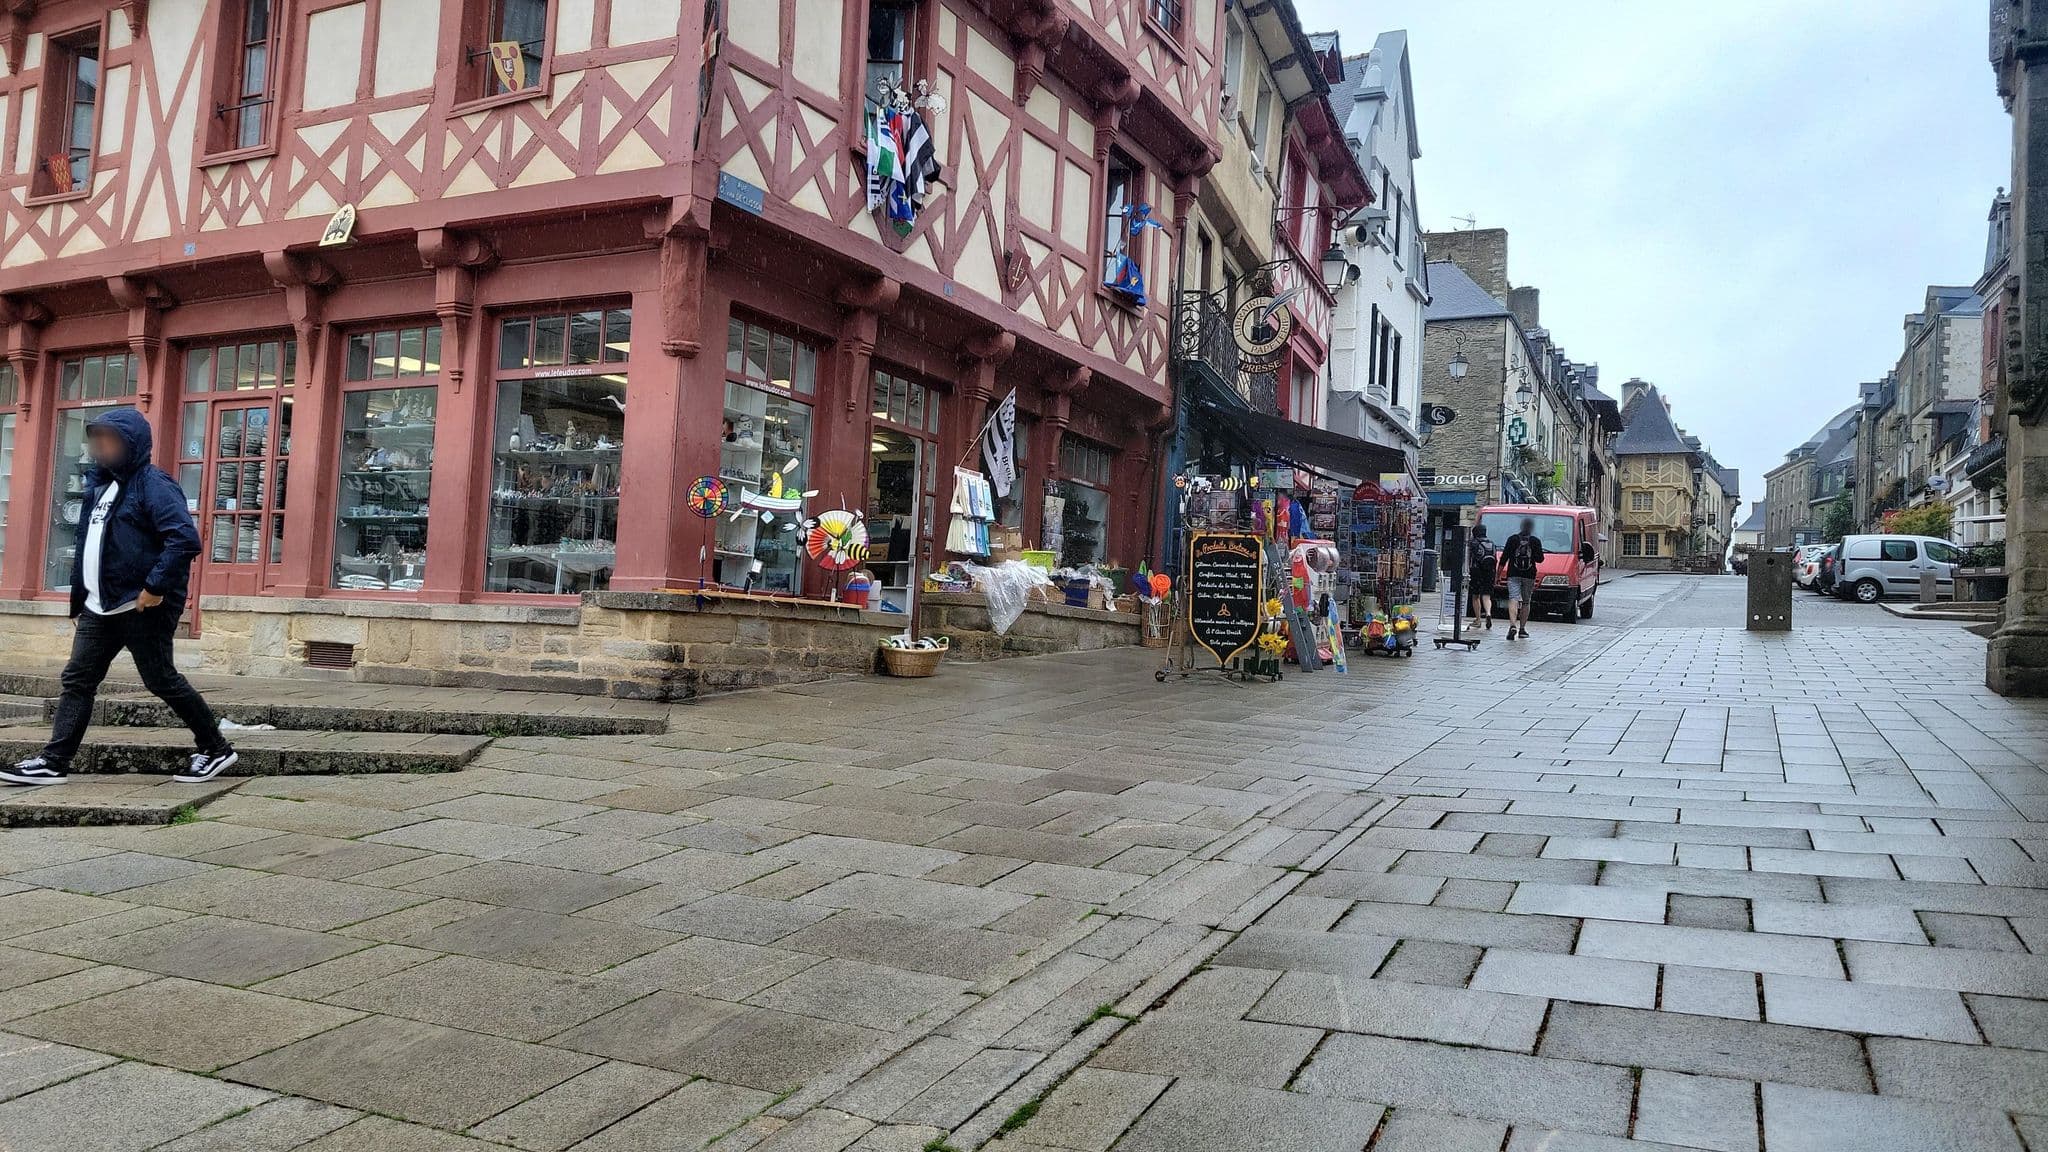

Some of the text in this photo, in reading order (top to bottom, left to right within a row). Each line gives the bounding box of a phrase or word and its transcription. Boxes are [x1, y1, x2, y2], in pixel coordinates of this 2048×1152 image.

[1235, 298, 1265, 337] LIBRAIRIE
[1251, 316, 1289, 354] PAPETERIE
[536, 368, 592, 377] www.lefeudor.com
[1241, 359, 1281, 372] PRESSE
